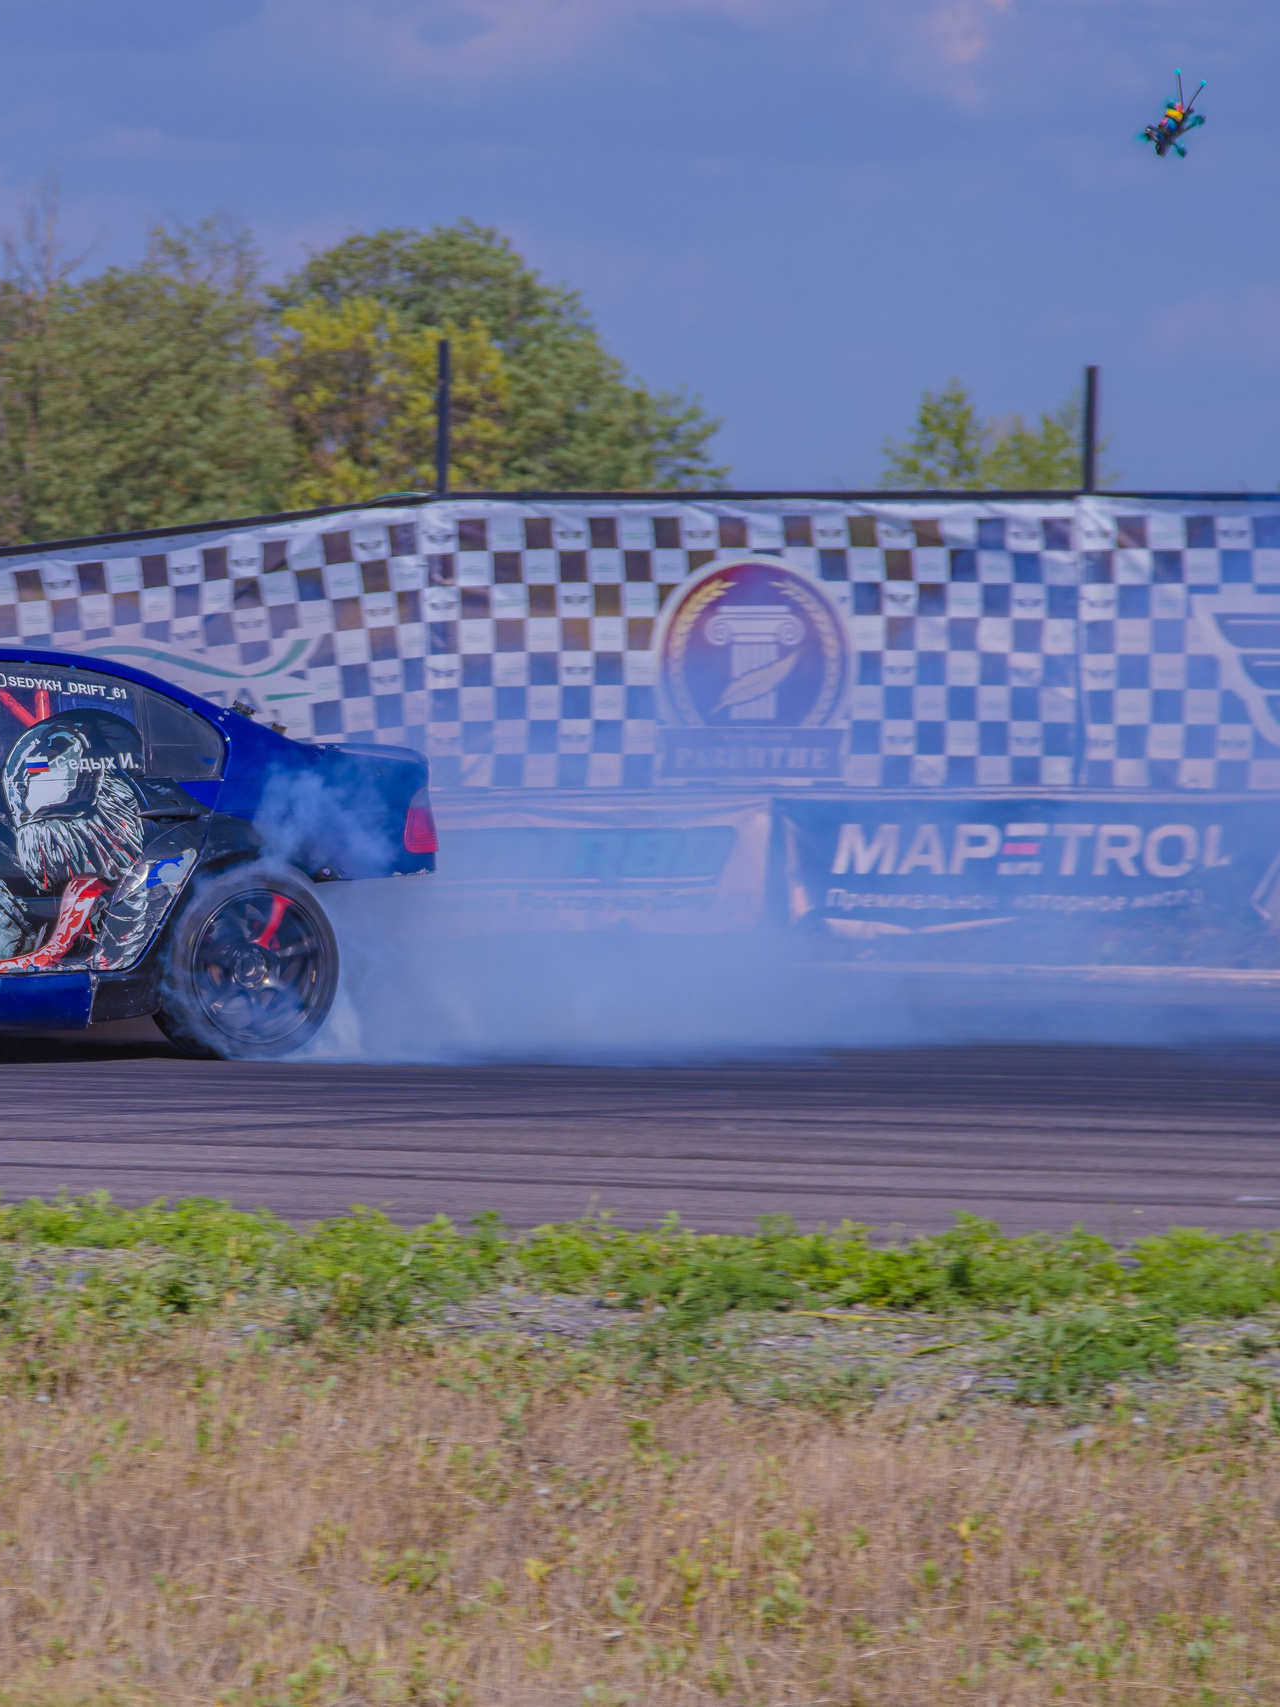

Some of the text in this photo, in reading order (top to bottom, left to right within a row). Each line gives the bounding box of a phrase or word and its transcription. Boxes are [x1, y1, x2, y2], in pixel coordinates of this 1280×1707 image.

[8, 676, 127, 700] SEDYKH_DRIFT_61
[55, 752, 140, 771] Седых И.
[831, 824, 1233, 877] MAPETROL
